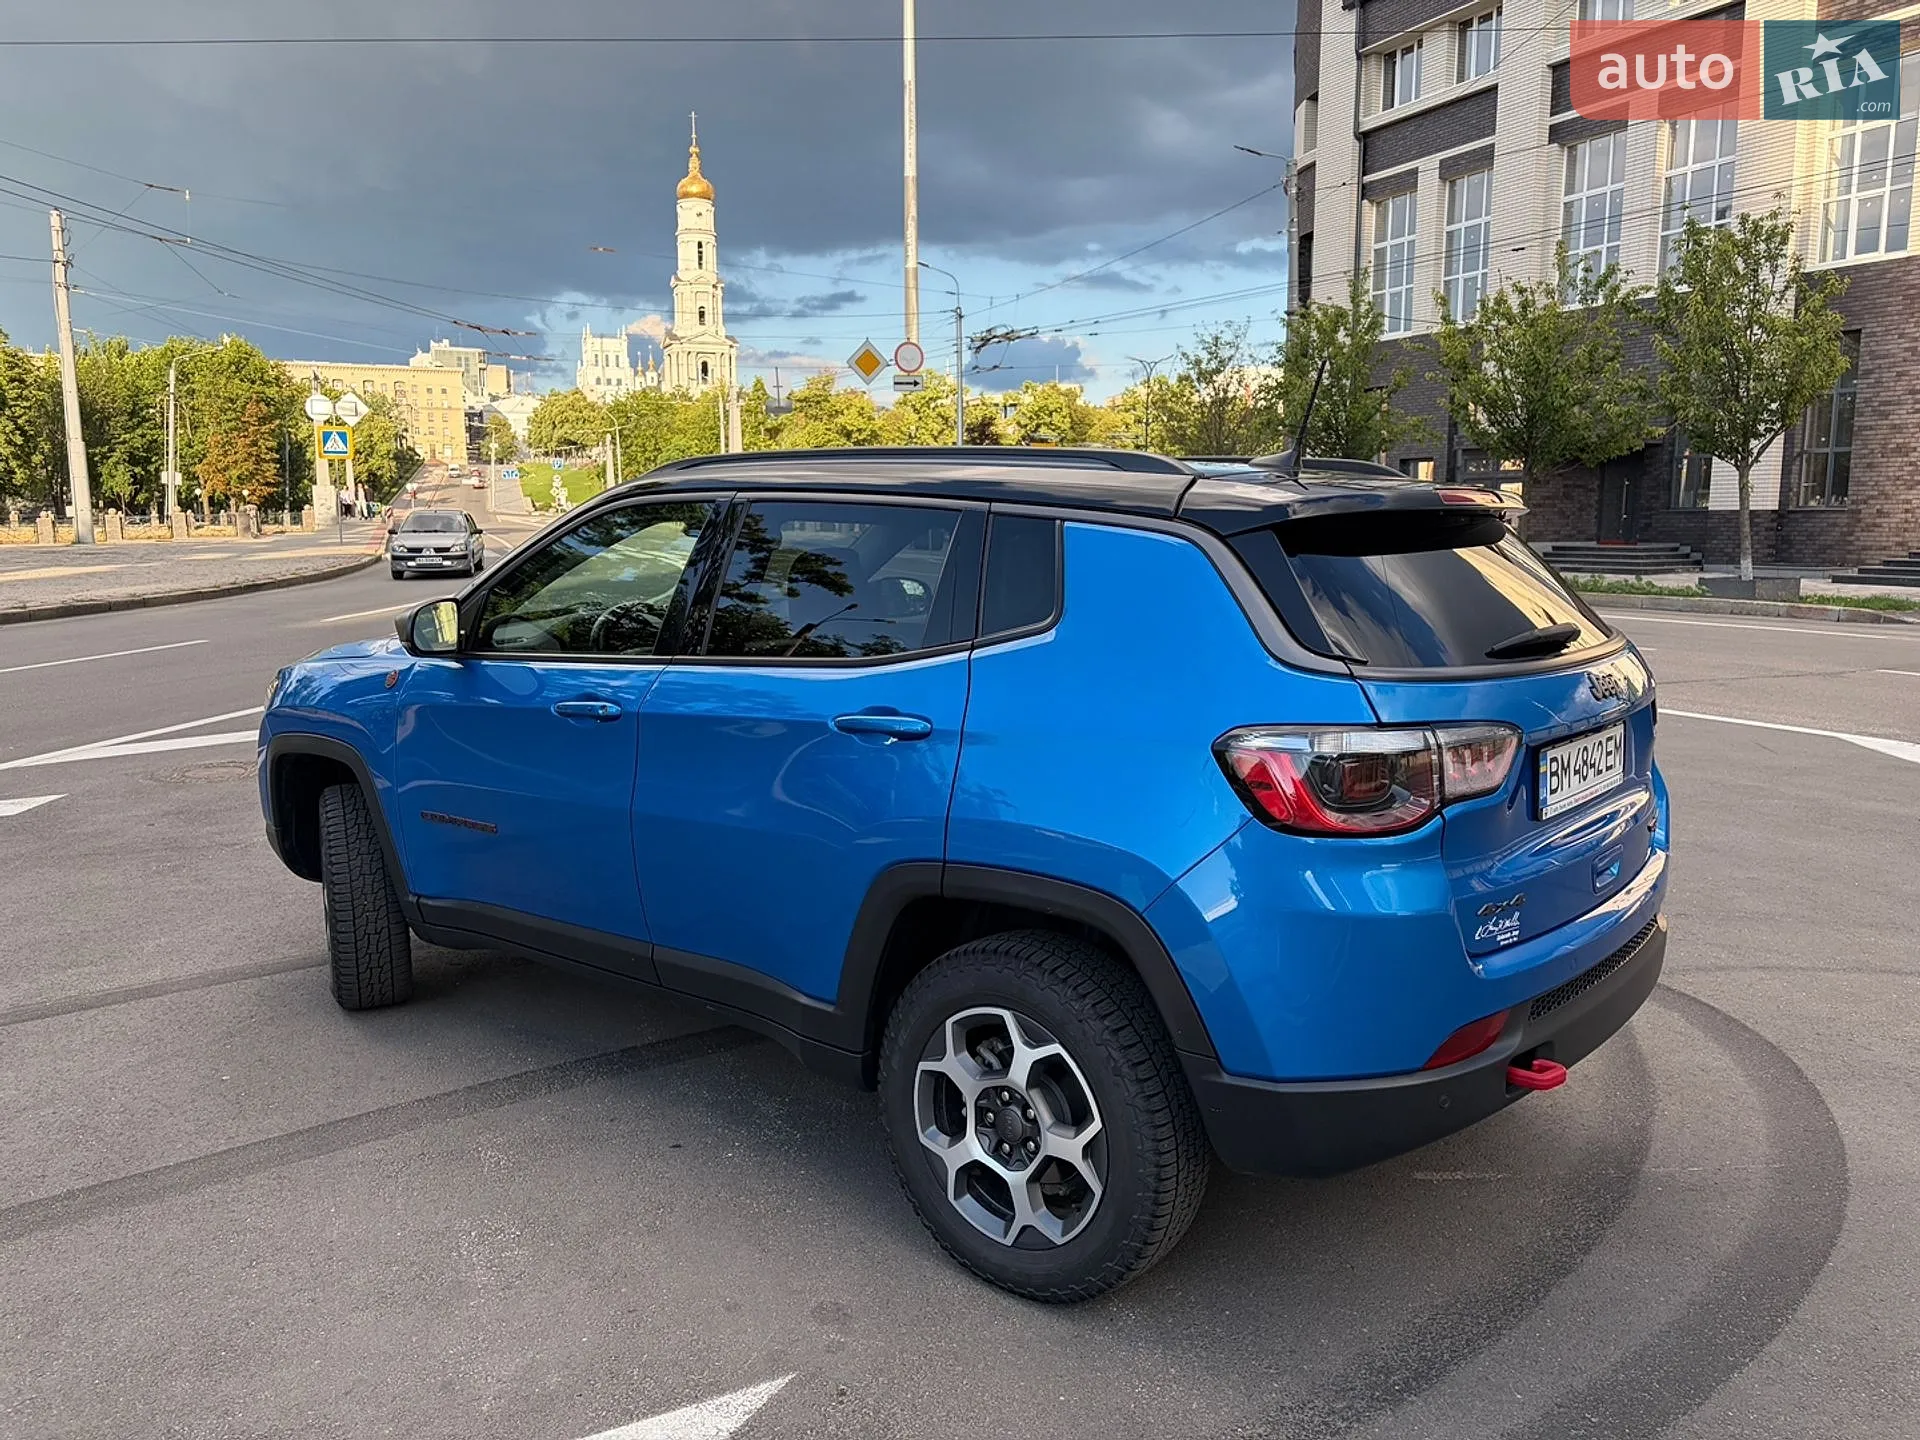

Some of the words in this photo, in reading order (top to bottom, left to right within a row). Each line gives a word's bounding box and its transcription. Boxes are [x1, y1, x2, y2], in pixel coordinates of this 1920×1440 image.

[1549, 752, 1571, 796] BM
[1573, 739, 1604, 784] 4842
[1605, 732, 1623, 772] EM
